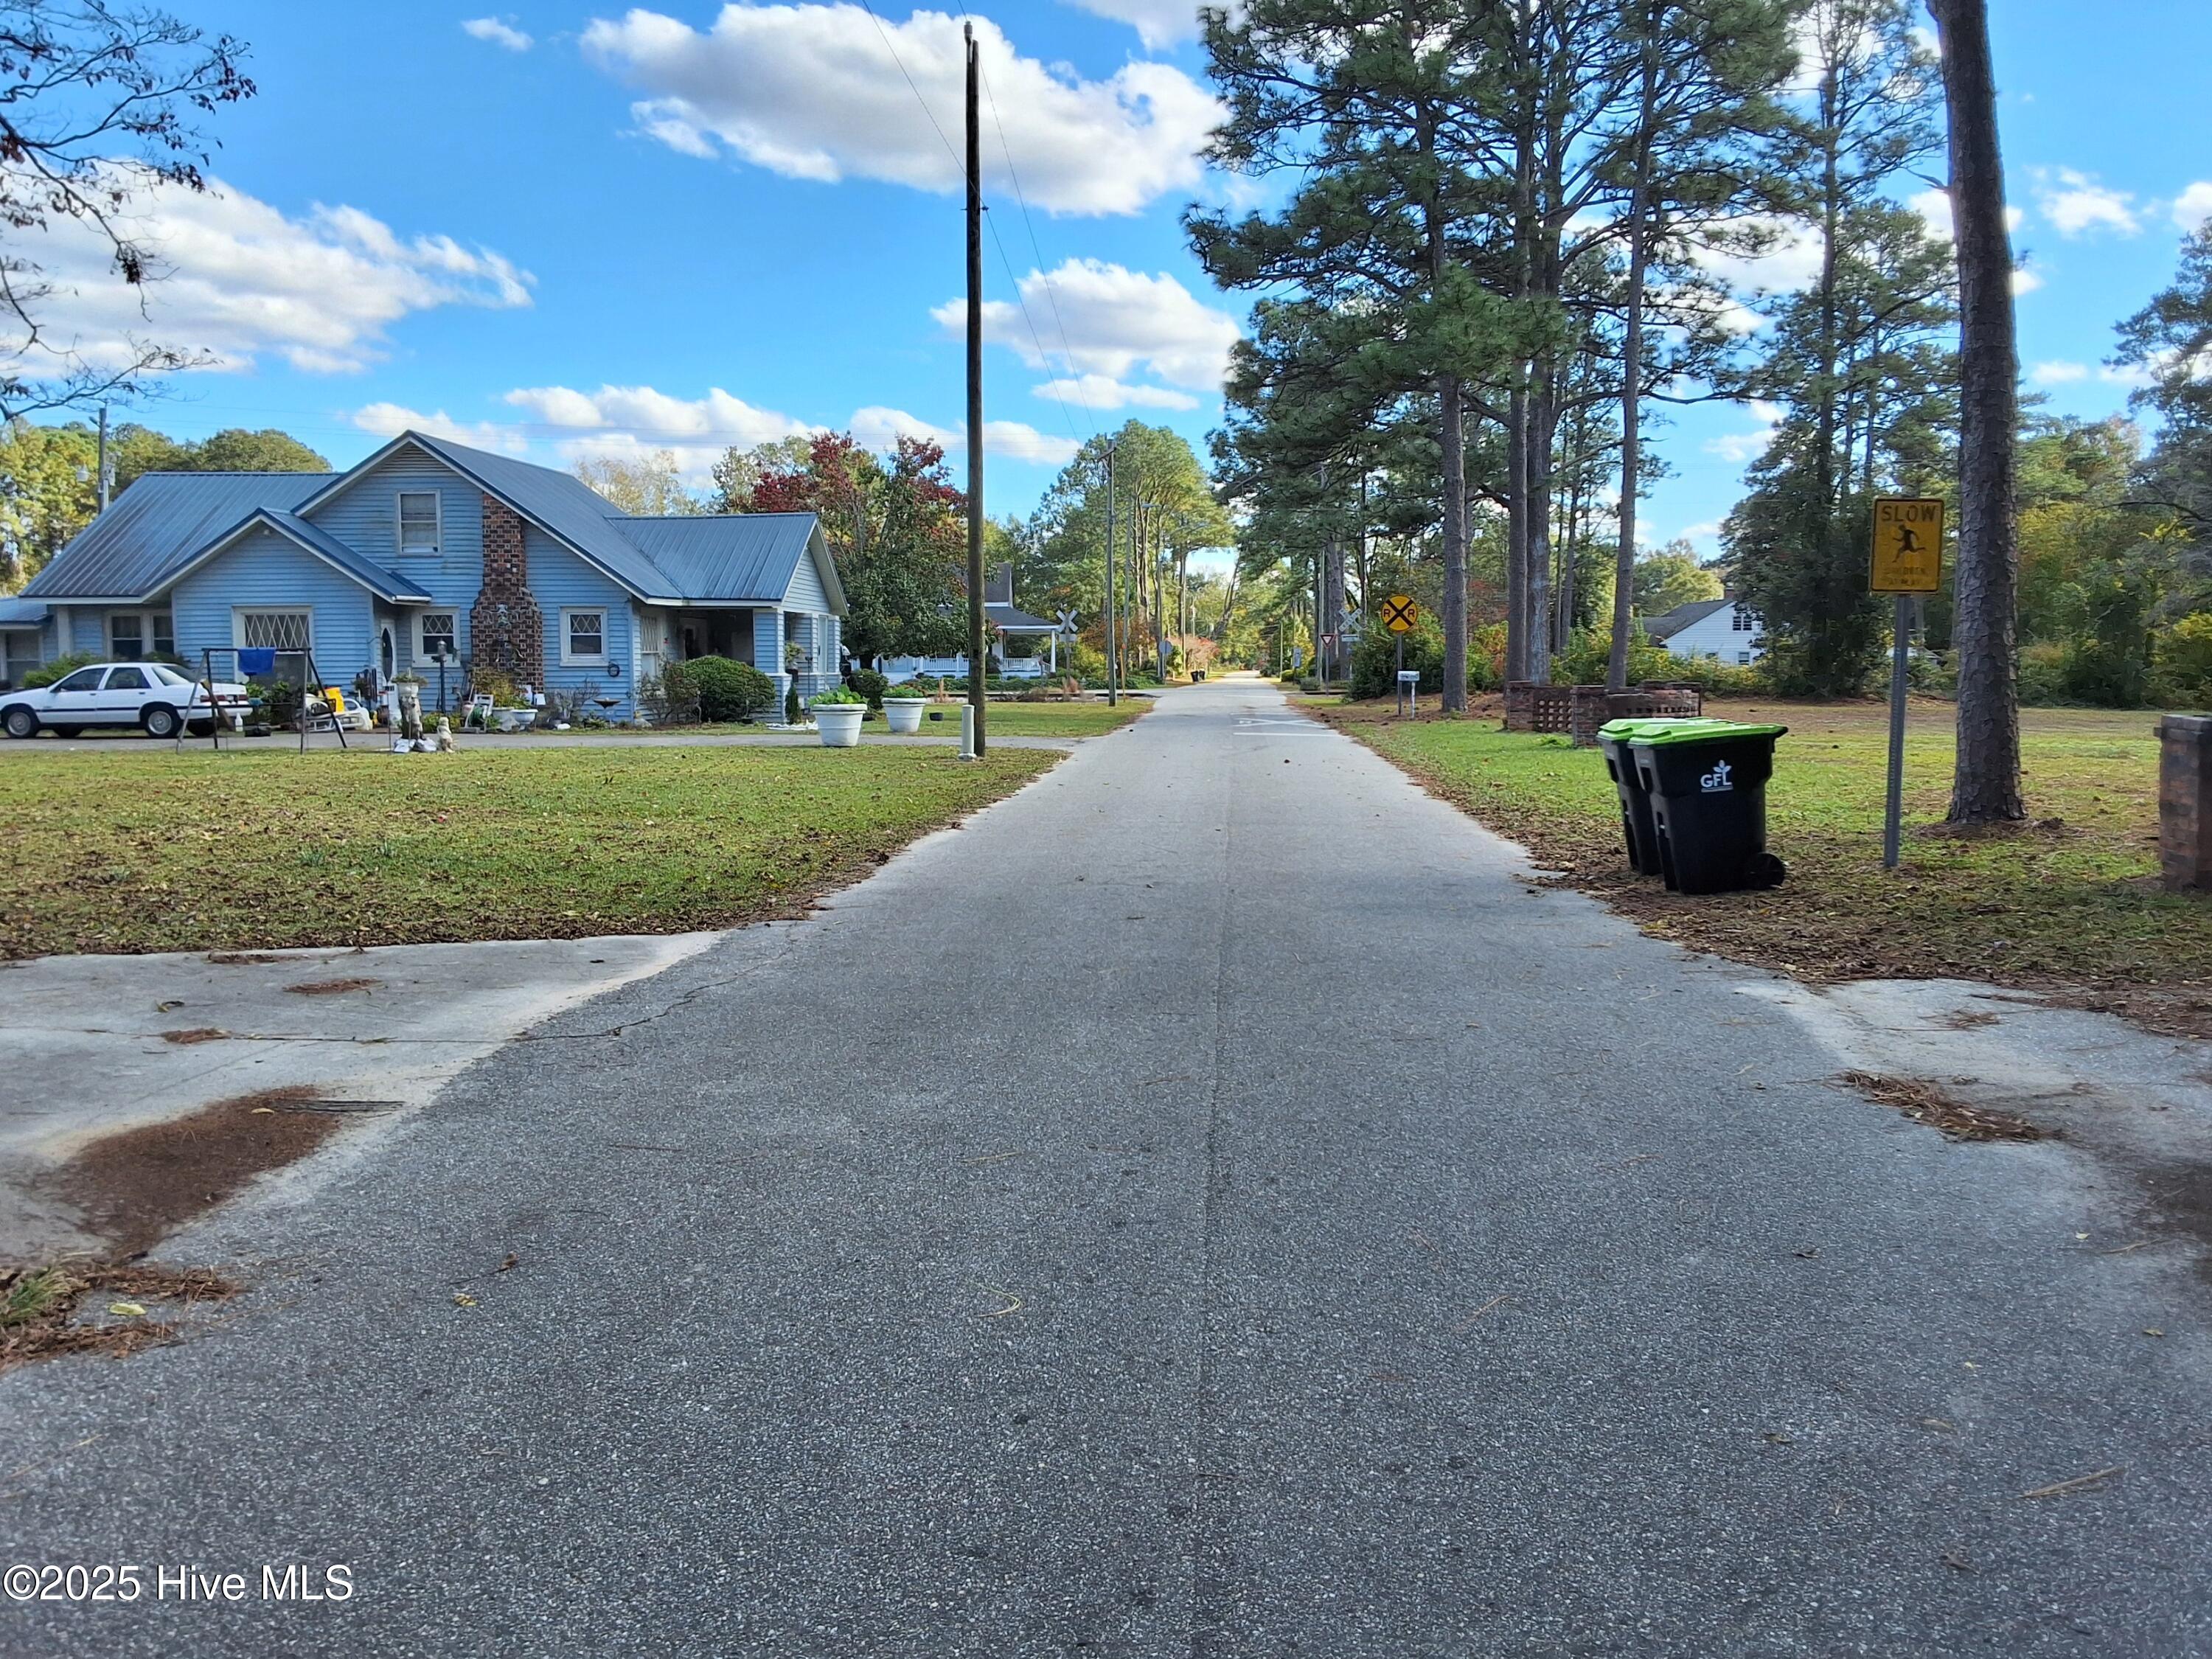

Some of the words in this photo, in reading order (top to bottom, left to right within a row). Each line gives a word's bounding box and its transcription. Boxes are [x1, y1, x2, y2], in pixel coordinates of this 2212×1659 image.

[1882, 504, 1936, 522] SLOW
[1383, 608, 1391, 618] R
[1408, 608, 1415, 618] R
[1700, 772, 1733, 787] GFL
